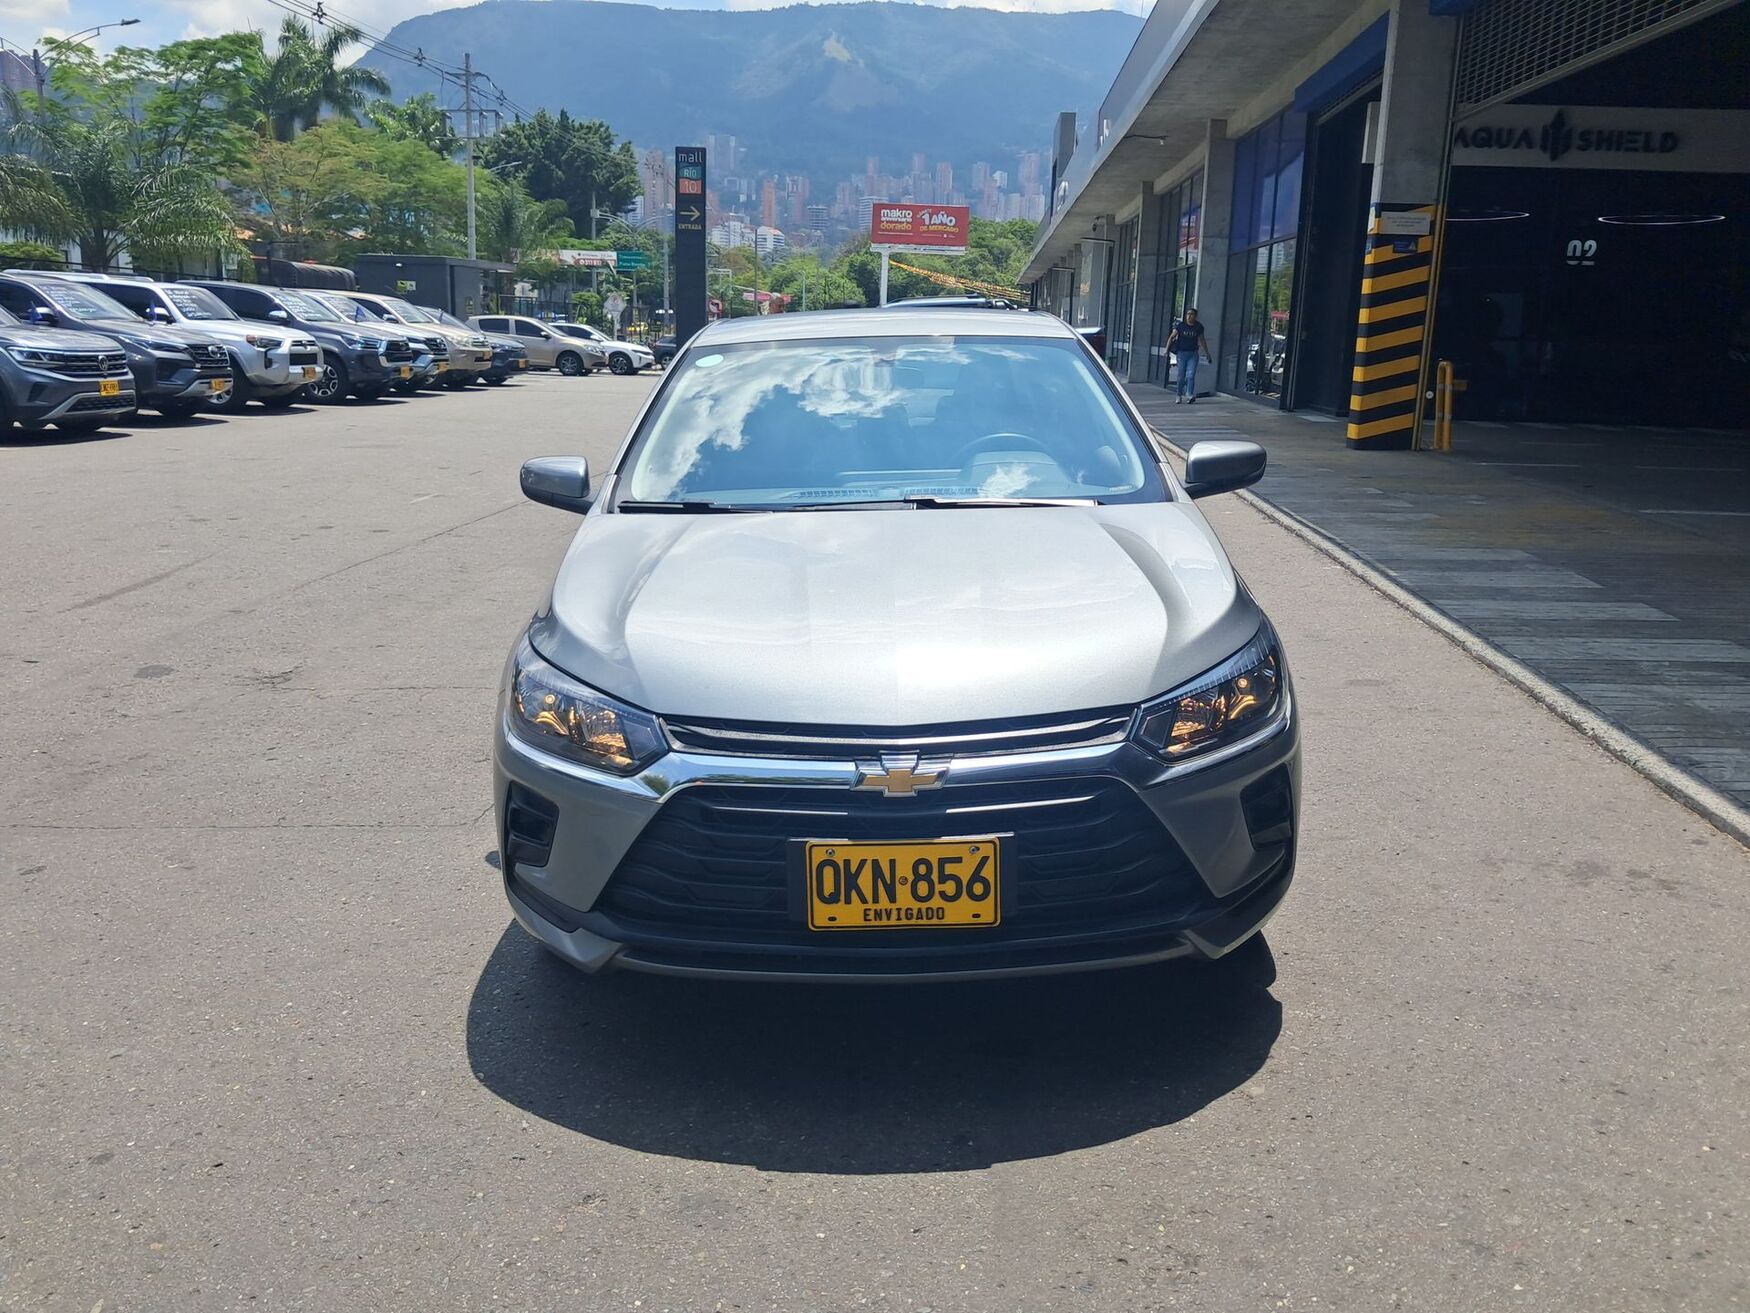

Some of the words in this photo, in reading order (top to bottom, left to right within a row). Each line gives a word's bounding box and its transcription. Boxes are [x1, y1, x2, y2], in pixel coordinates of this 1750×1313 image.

[1454, 126, 1533, 149] AQUA
[1576, 130, 1680, 153] SHIELD
[679, 152, 702, 163] mall
[881, 208, 912, 218] makro
[922, 213, 930, 225] 1
[931, 211, 956, 226] AÑO
[880, 221, 912, 230] dorado
[1567, 240, 1597, 266] 02
[815, 858, 897, 905] QKN
[910, 855, 991, 904] 856
[863, 907, 945, 921] ENVIGADO
